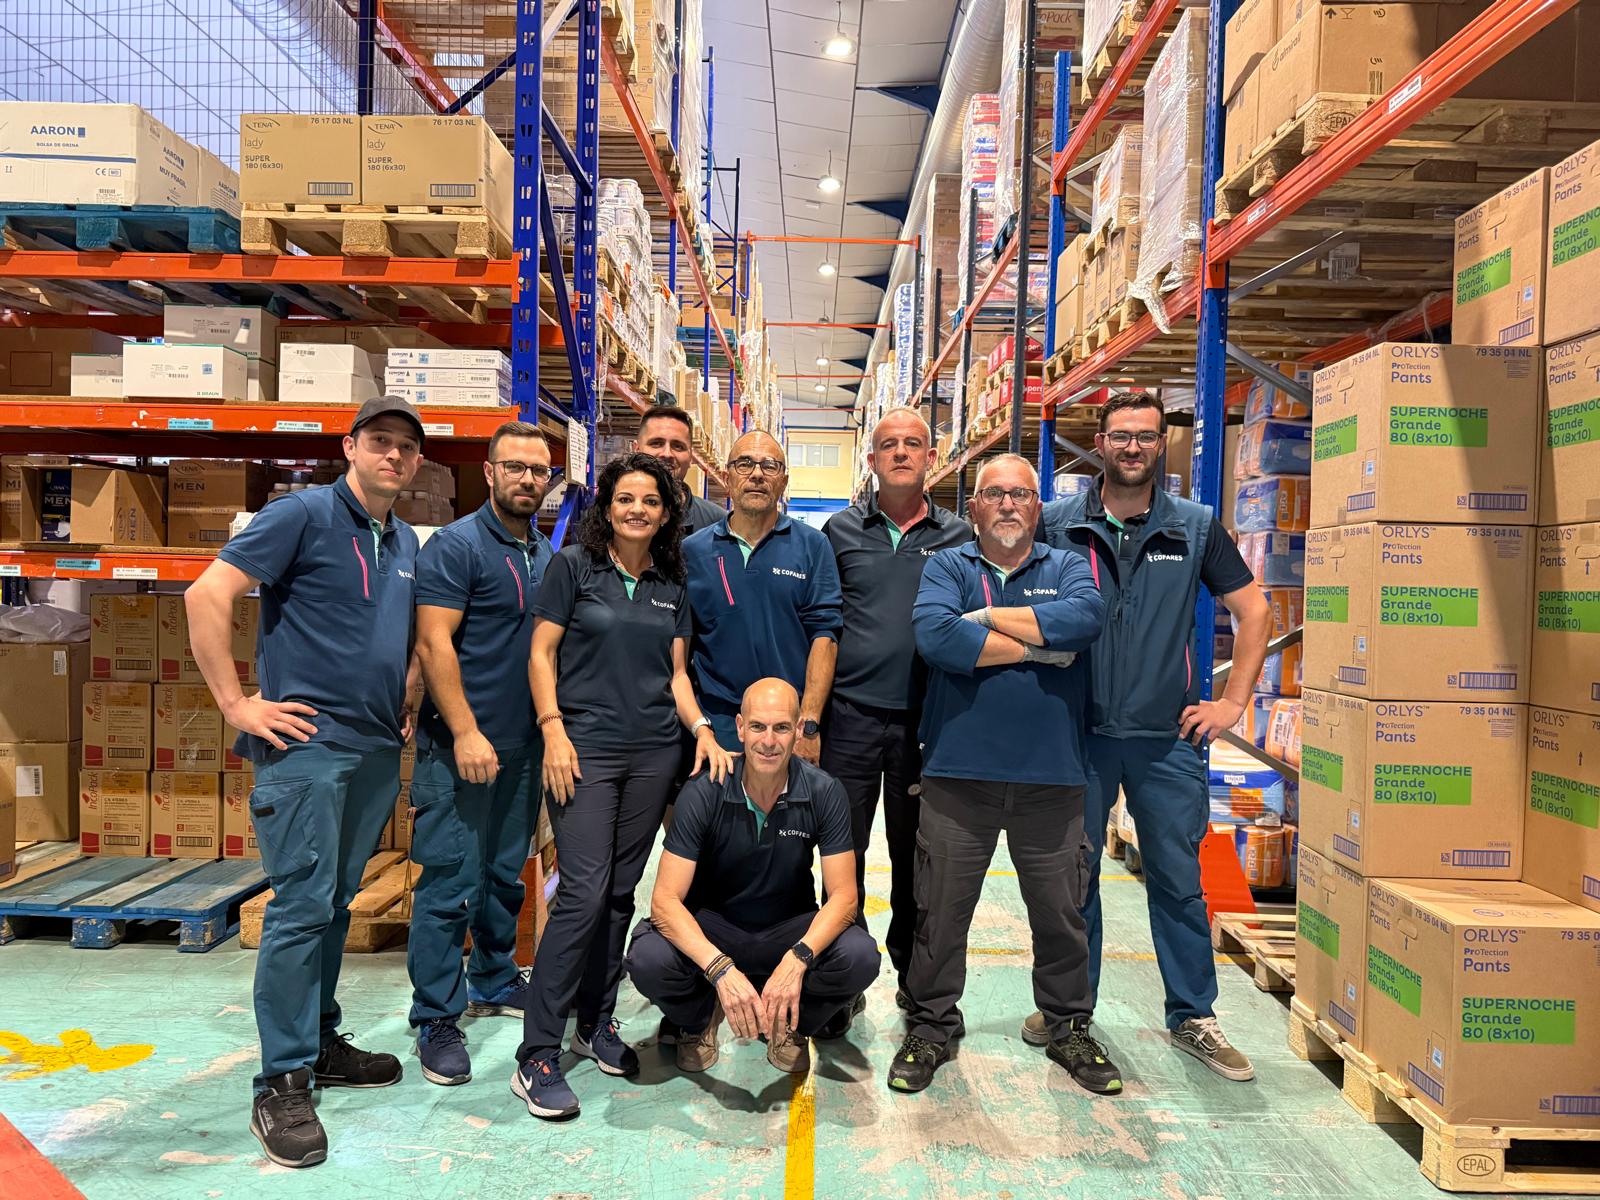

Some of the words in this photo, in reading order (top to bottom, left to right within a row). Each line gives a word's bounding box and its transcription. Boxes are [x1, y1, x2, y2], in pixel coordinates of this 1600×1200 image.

[31, 126, 75, 135] AARON
[244, 138, 263, 149] lady
[367, 139, 386, 150] lady
[1555, 182, 1582, 203] Pants
[1458, 233, 1479, 252] Pants
[1553, 228, 1589, 251] Grande
[1553, 252, 1565, 264] 80
[1568, 236, 1596, 260] (8x10)
[1457, 247, 1511, 281] SUPERNOCHE
[1457, 274, 1484, 292] Grande
[1476, 348, 1486, 356] 79
[1489, 348, 1500, 356] 35
[1504, 348, 1515, 357] 04
[1518, 349, 1532, 358] NL
[1391, 371, 1432, 384] Pants
[1549, 370, 1576, 385] Pants
[1315, 392, 1332, 406] Pants
[1390, 406, 1488, 418] SUPERNOCHE
[1314, 415, 1357, 436] SUPERNOCHE
[1390, 419, 1441, 430] Grande
[1548, 418, 1583, 433] Grande
[1390, 433, 1408, 442] 80
[1412, 433, 1452, 446] (8x10)
[1548, 435, 1560, 446] 80
[1562, 428, 1591, 445] (8x10)
[174, 482, 205, 490] MEN
[44, 496, 70, 504] MEN
[1466, 528, 1477, 536] 79
[1480, 528, 1492, 536] 35
[1494, 528, 1506, 536] 04
[1508, 528, 1522, 538] NL
[1154, 554, 1184, 562] COFARES
[1307, 555, 1324, 565] Pants
[1382, 551, 1422, 564] Pants
[1540, 556, 1566, 567] Pants
[1307, 586, 1349, 596] SUPERNOCHE
[1381, 586, 1479, 598] SUPERNOCHE
[1306, 598, 1328, 607] Grande
[1381, 599, 1432, 610] Grande
[1538, 604, 1572, 615] Grande
[1381, 612, 1399, 622] 80
[1403, 613, 1443, 624] (8x10)
[1538, 618, 1550, 628] 80
[1552, 618, 1580, 630] (8x10)
[162, 687, 172, 725] IncoPack
[1460, 706, 1471, 715] 79
[1474, 707, 1485, 715] 35
[1488, 707, 1499, 716] 04
[1502, 708, 1516, 716] NL
[1303, 713, 1318, 726] Pants
[1376, 730, 1416, 743] Pants
[1533, 736, 1559, 752] Pants
[1302, 744, 1343, 765] SUPERNOCHE
[1374, 764, 1472, 776] SUPERNOCHE
[1374, 777, 1425, 788] Grande
[1532, 770, 1600, 797] SUPERNOCHE
[88, 772, 98, 810] IncoPack
[160, 774, 170, 812] IncoPack
[232, 776, 243, 814] IncoPack
[1374, 790, 1392, 800] 80
[1396, 791, 1437, 804] (8x10)
[1531, 784, 1566, 803] Grande
[1531, 796, 1542, 809] 80
[1545, 801, 1573, 820] (8x10)
[1370, 910, 1390, 930] Pants
[1440, 921, 1450, 934] NL
[1561, 931, 1573, 940] 79
[1577, 931, 1590, 940] 35
[1464, 948, 1508, 956] ProTection
[1368, 958, 1395, 983] Grande
[1369, 944, 1422, 987] SUPERNOCHE
[1464, 958, 1510, 972] Pants
[1368, 971, 1378, 985] 80
[1462, 997, 1576, 1011] SUPERNOCHE
[1462, 1012, 1521, 1025] Grande
[1462, 1027, 1483, 1038] 80
[1488, 1028, 1535, 1043] (8x10)
[1462, 1156, 1491, 1172] EPAL
